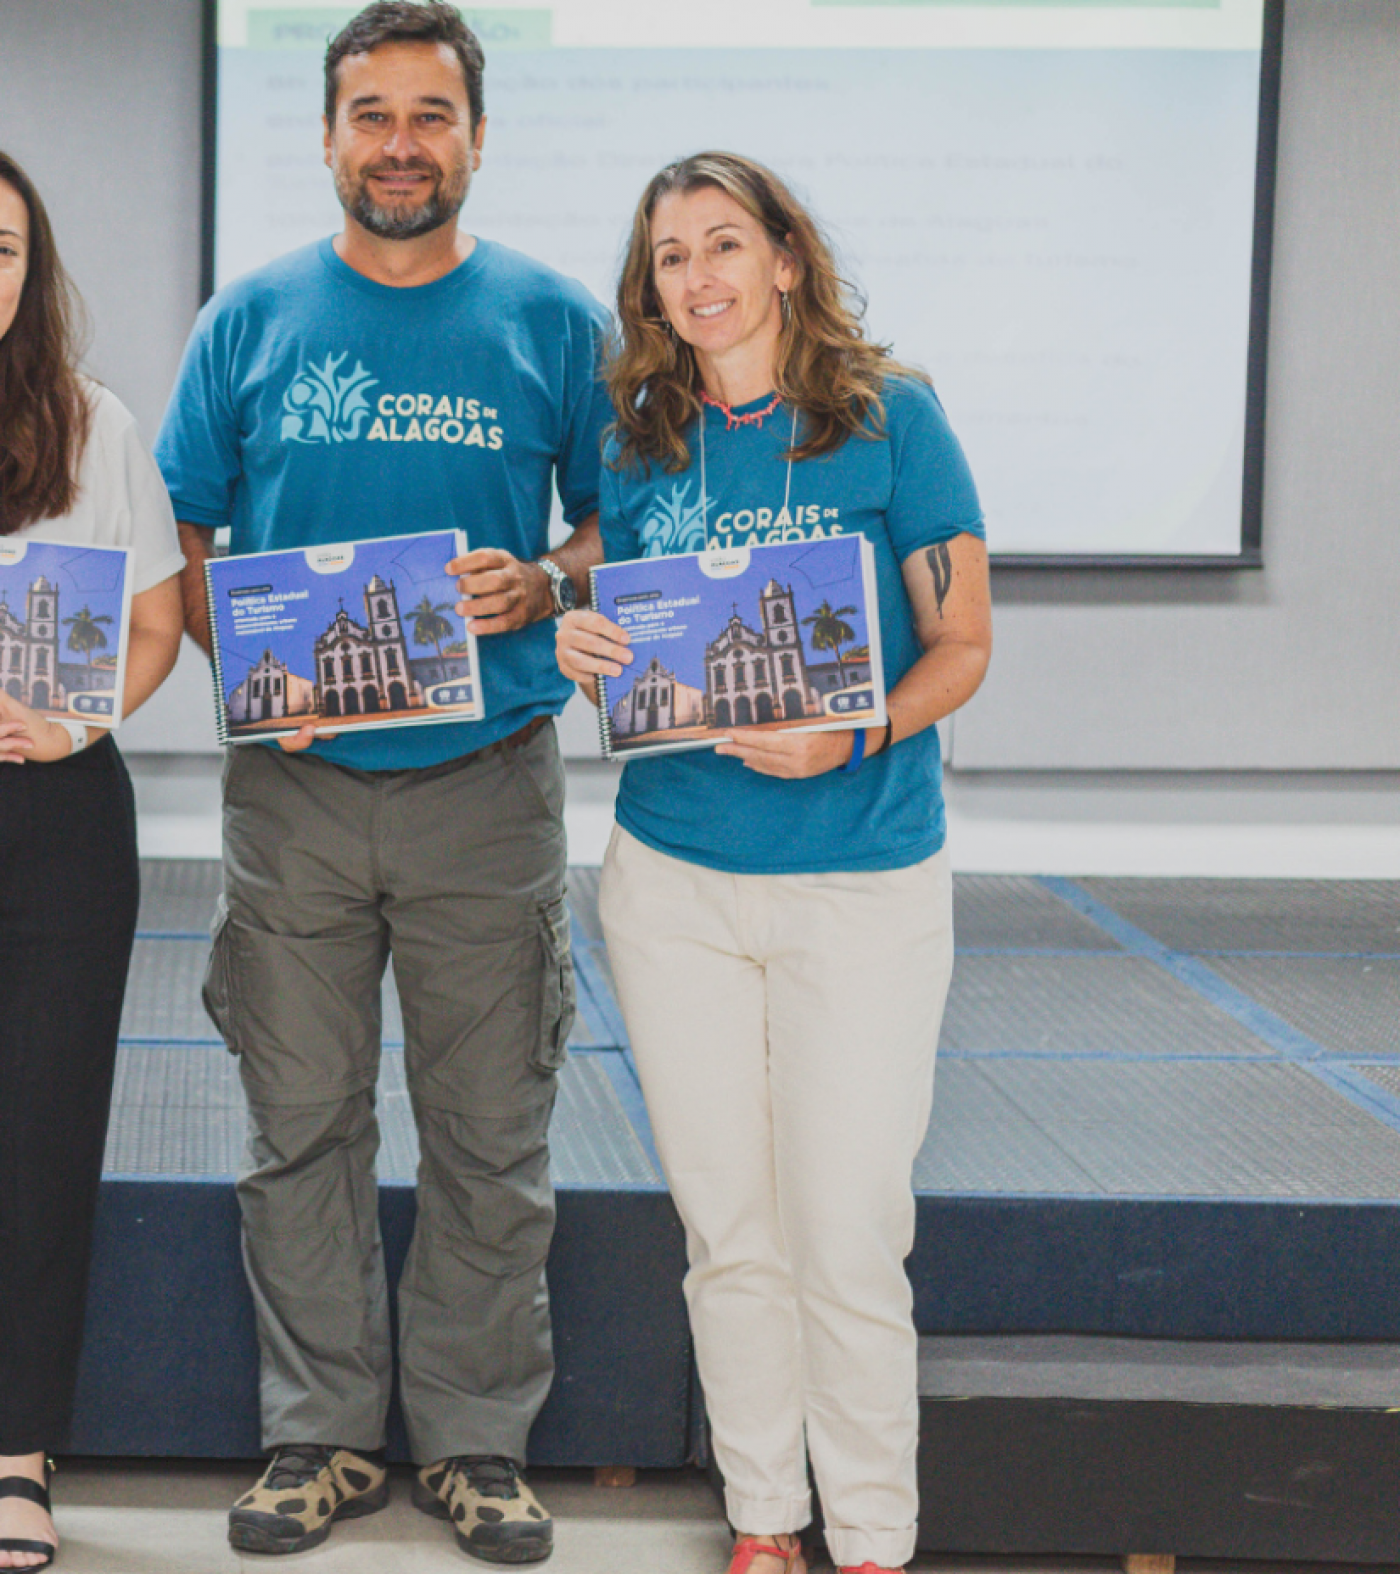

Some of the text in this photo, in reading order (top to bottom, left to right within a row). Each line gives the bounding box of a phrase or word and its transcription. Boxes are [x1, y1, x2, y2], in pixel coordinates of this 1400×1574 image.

[378, 393, 498, 420] CORAIS DE
[366, 416, 503, 450] ALAGOAS
[715, 504, 839, 534] CORAIS DE
